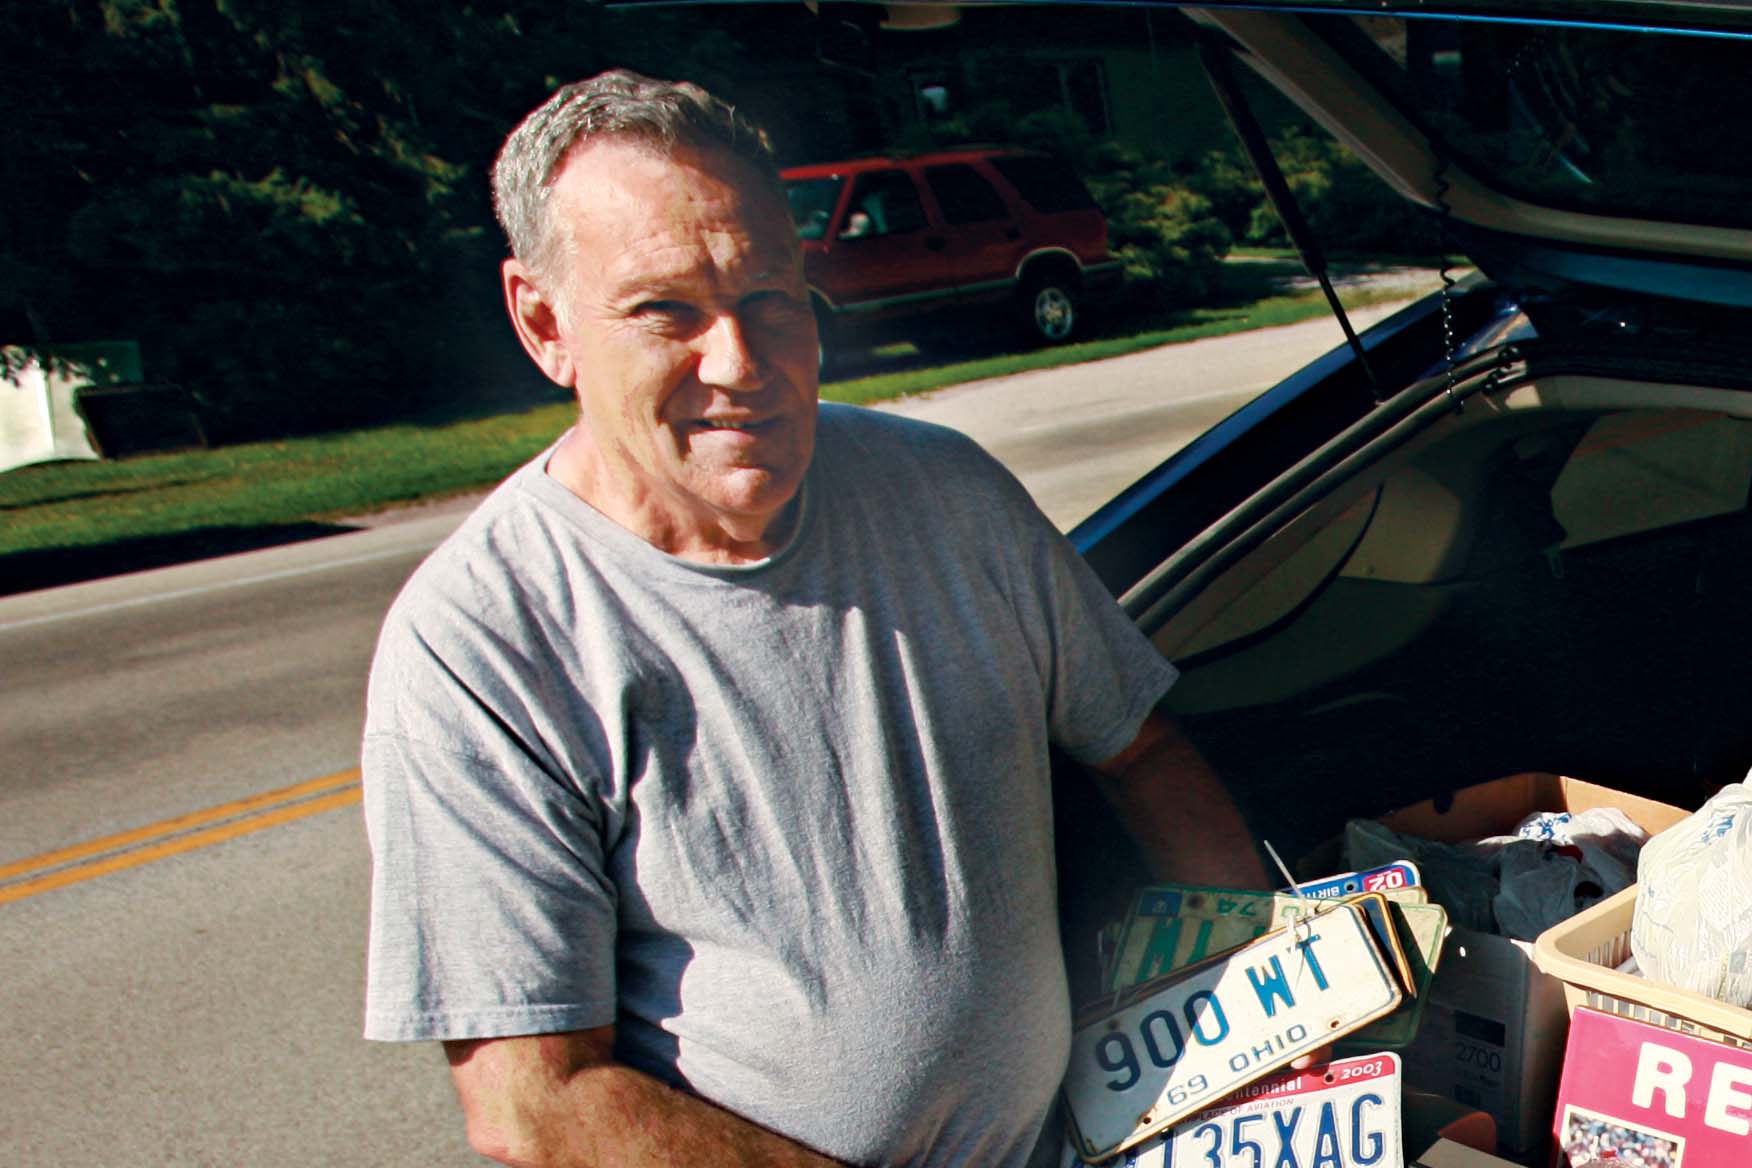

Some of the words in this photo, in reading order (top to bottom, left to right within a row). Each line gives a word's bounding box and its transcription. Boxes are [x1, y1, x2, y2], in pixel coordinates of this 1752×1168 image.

[1096, 990, 1230, 1092] 900
[1245, 934, 1329, 1018] WT
[1167, 1074, 1208, 1105] 69
[1229, 1024, 1307, 1073] OHIO
[1340, 1060, 1383, 1080] 2003
[1247, 1098, 1294, 1111] AVIATION
